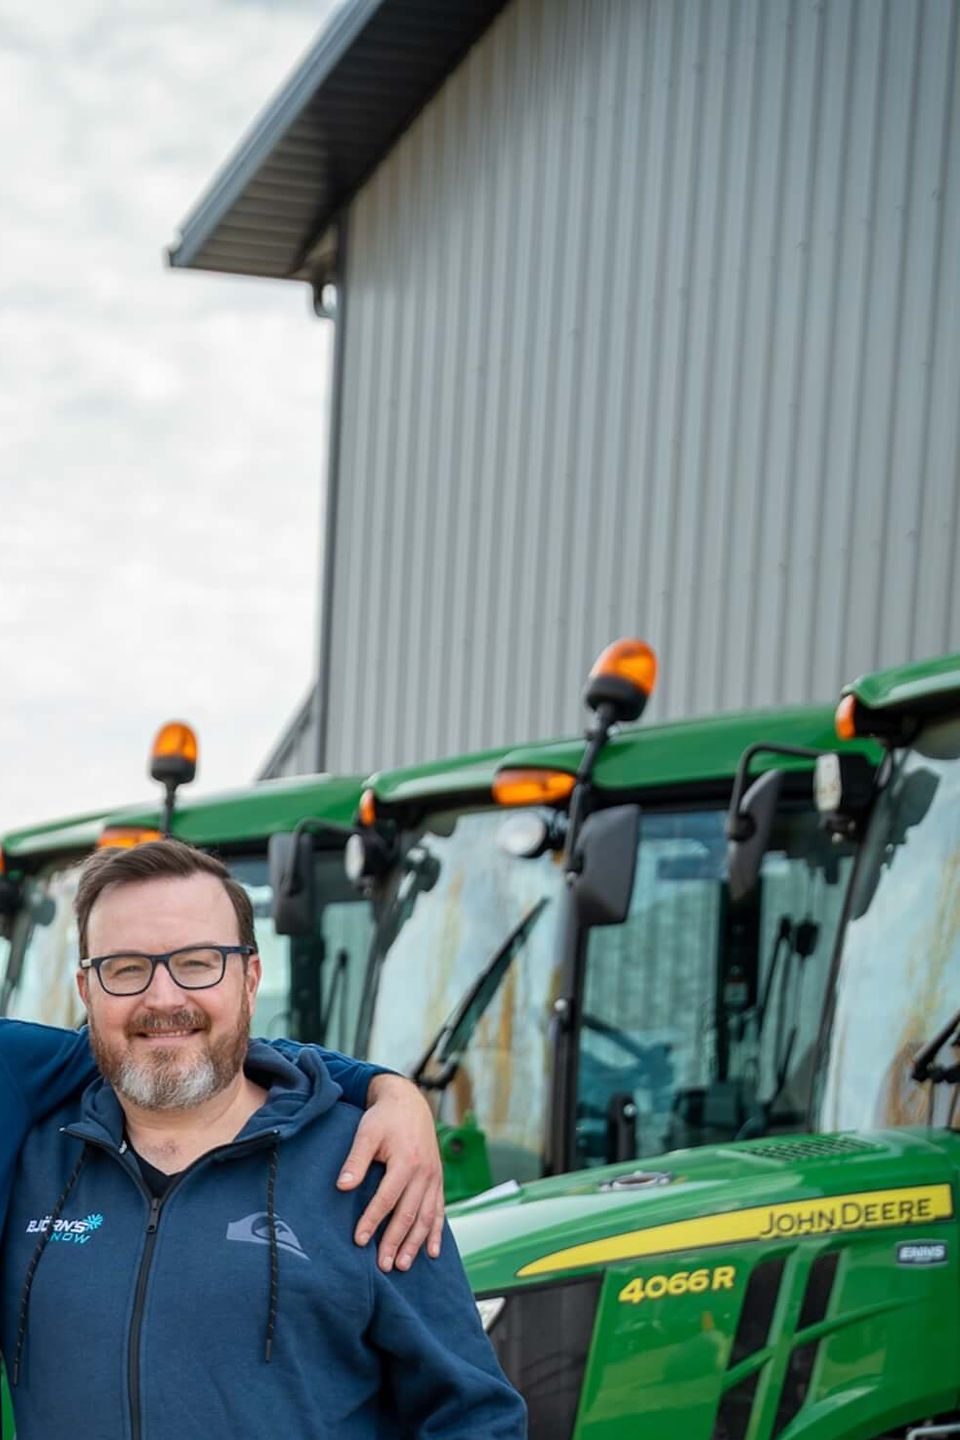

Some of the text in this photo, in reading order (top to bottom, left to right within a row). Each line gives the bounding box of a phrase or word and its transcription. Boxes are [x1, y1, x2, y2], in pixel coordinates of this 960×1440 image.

[760, 1198, 932, 1237] JOHN DEERE
[49, 1232, 91, 1244] NOW
